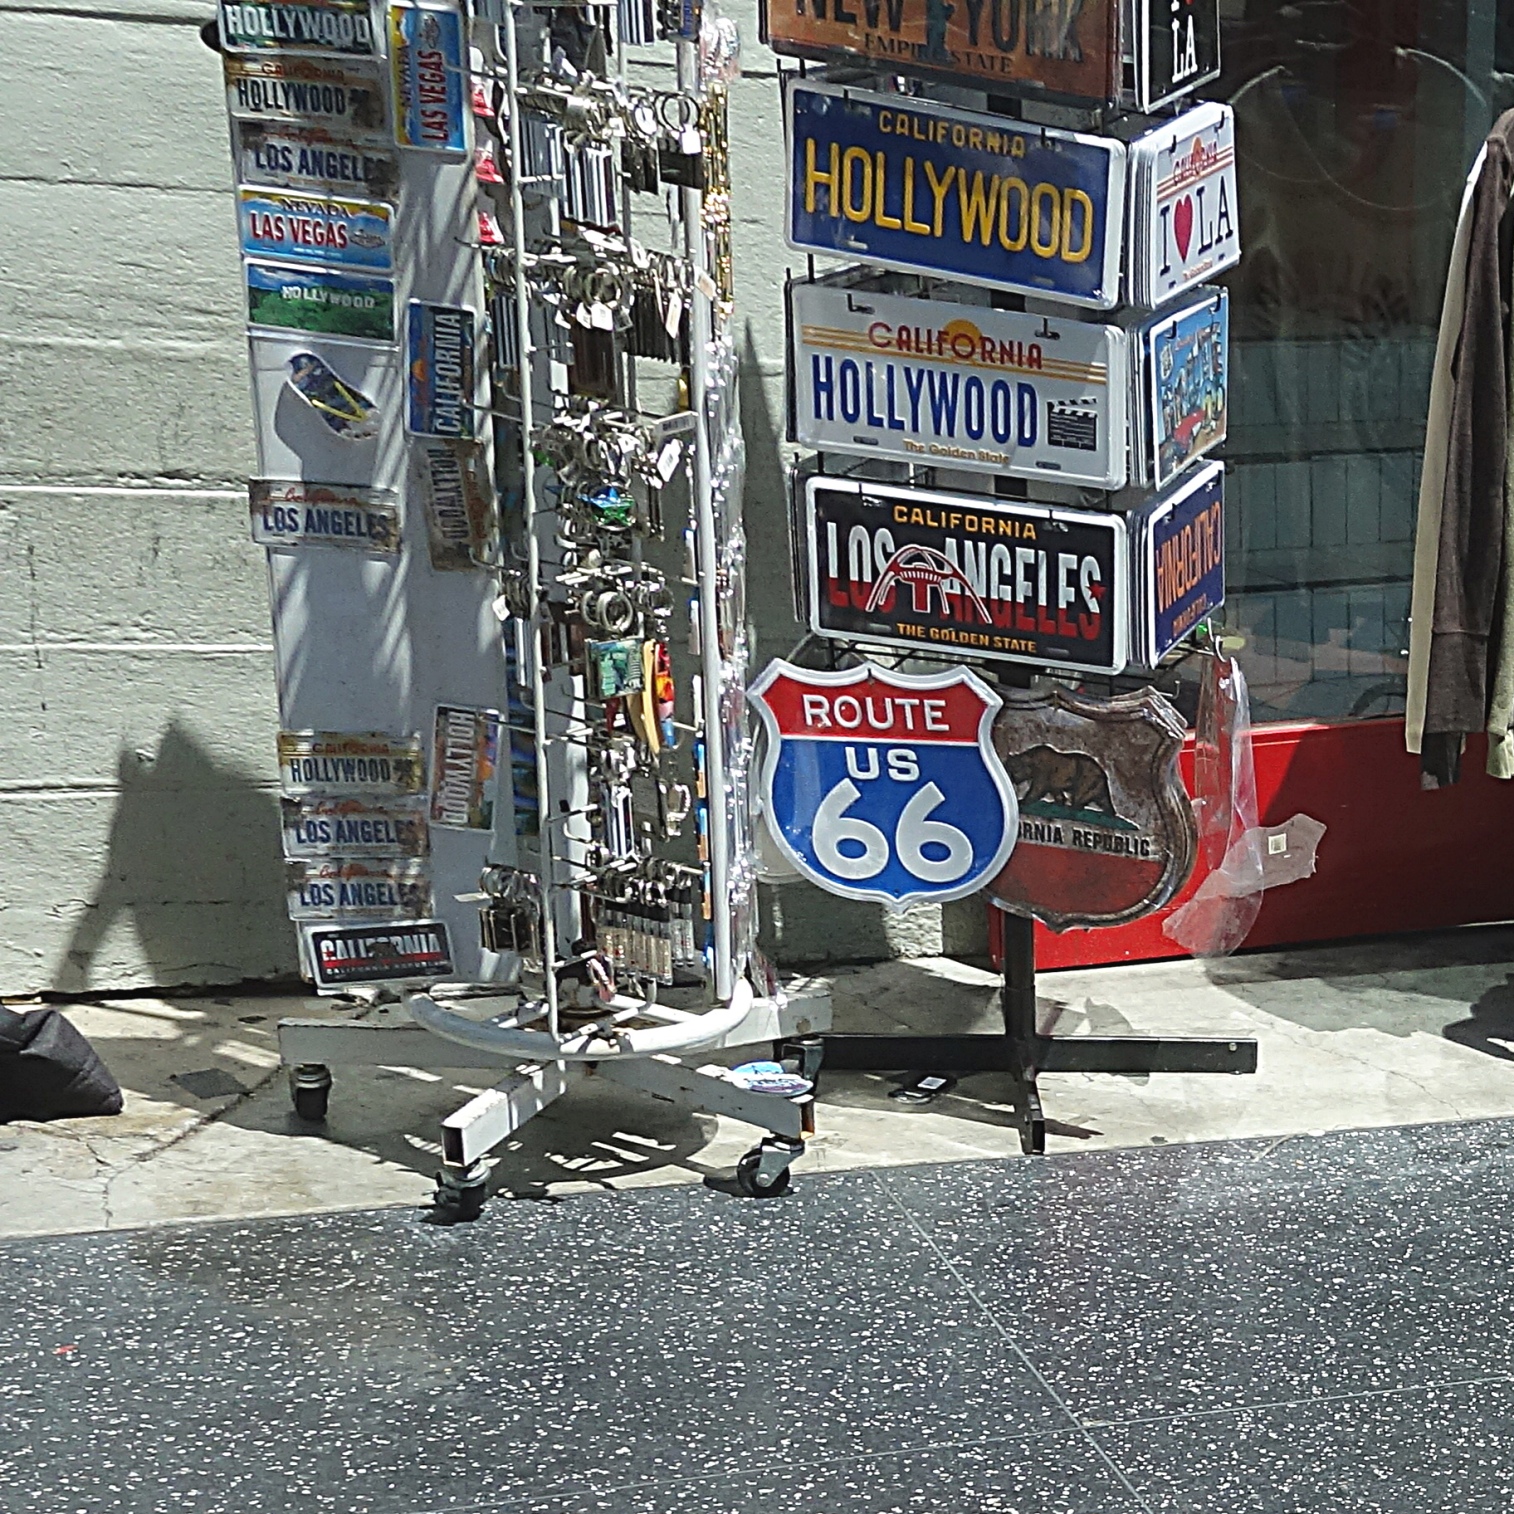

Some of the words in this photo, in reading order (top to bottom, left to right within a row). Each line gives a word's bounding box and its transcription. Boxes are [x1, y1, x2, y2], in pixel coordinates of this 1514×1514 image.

[224, 4, 371, 43] HOLLYWOOD
[953, 51, 1012, 74] STATE
[1171, 14, 1198, 83] LA
[417, 50, 446, 104] VEGAS
[236, 77, 346, 116] HOLLYWOOD
[421, 108, 449, 141] LAS
[879, 110, 1026, 157] CALIFORNIA
[254, 143, 294, 173] LOS
[282, 197, 354, 218] NEVADA
[805, 137, 1094, 264] HOLLYWOOD
[250, 211, 285, 241] LAS
[288, 217, 348, 249] VEGAS
[1160, 205, 1170, 276] I
[1196, 175, 1234, 256] LA
[281, 285, 376, 309] HOLLYWOOD
[868, 321, 1043, 370] CALIFORNIA
[434, 313, 463, 434] CALIFORNIA
[811, 353, 1038, 449] HOLLYWOOD
[902, 437, 926, 453] The
[928, 441, 976, 462] Golden
[978, 447, 1010, 466] State
[263, 504, 299, 532] LOS
[304, 508, 390, 540] ANGELES
[893, 505, 1037, 541] CALIFORNIA
[1156, 501, 1221, 614] CALIFORNIA
[827, 521, 896, 614] LOS
[939, 537, 1103, 641] ANGELES
[897, 622, 926, 639] THE
[929, 627, 989, 647] GOLDEN
[993, 636, 1037, 653] STATE
[801, 693, 951, 734] ROUTE
[290, 757, 391, 783] HOLLYWOOD
[441, 711, 476, 824] HOLLYWOOD
[845, 745, 920, 783] US
[296, 820, 331, 844] LOS
[810, 779, 974, 883] 66
[1072, 829, 1151, 857] REPUBLIC
[300, 882, 335, 907] LOS
